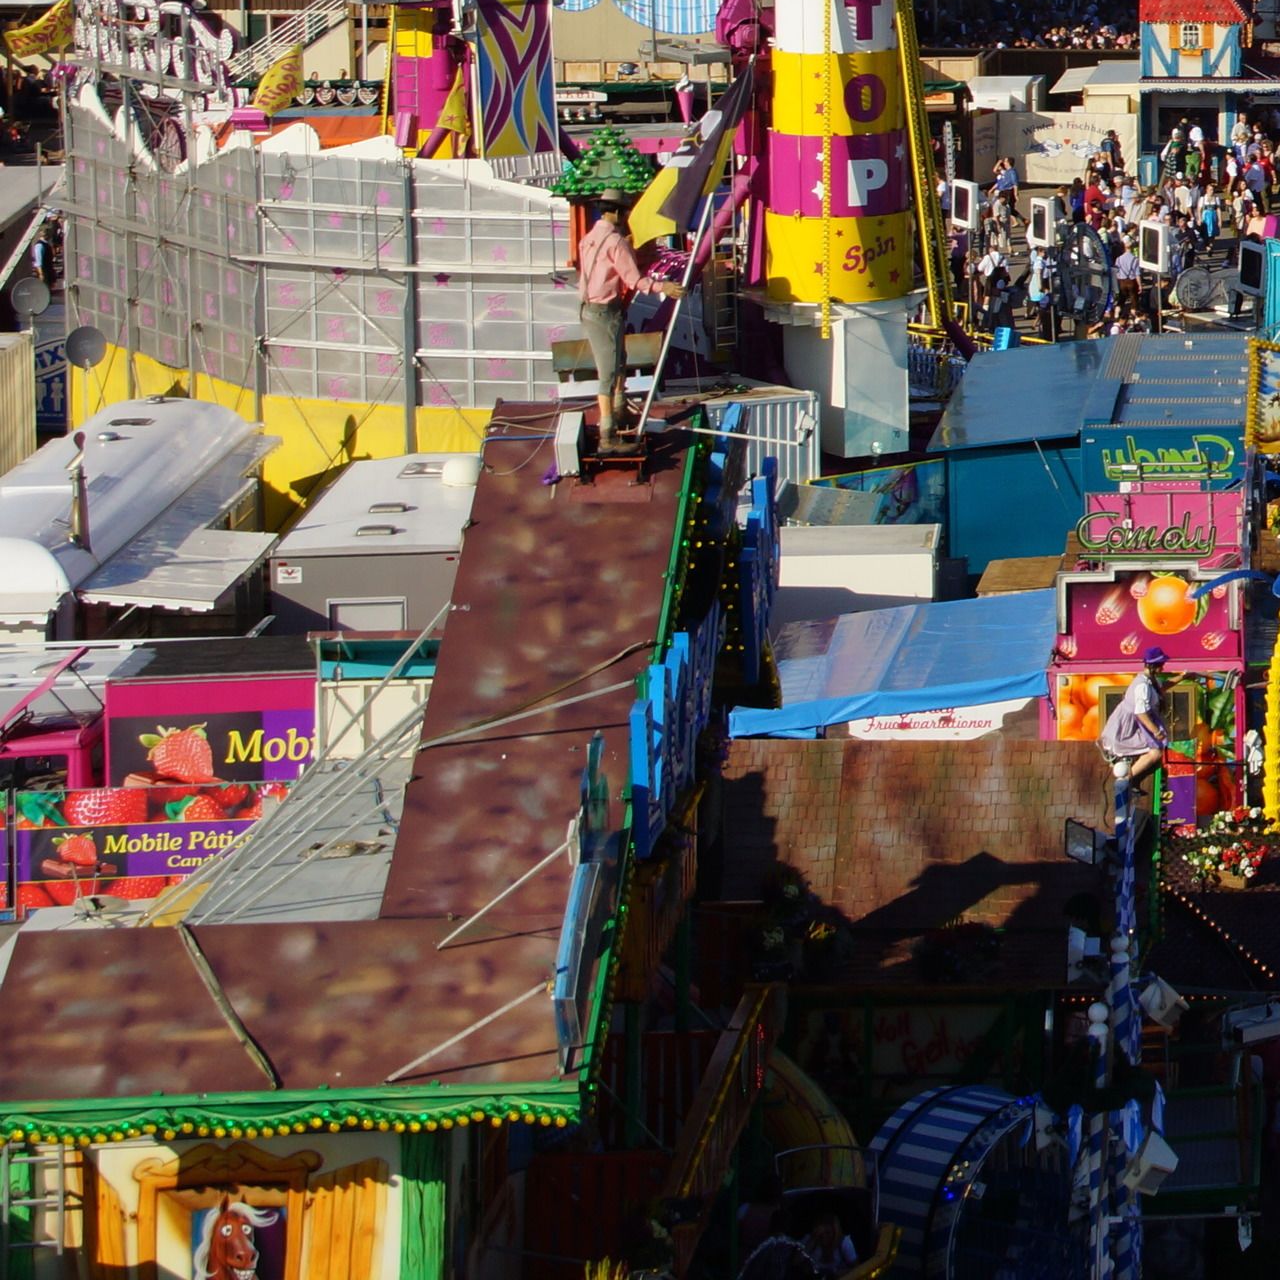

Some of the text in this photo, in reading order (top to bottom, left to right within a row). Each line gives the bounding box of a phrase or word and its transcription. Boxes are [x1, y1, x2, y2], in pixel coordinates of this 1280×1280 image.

[842, 230, 897, 275] Spin
[1076, 511, 1217, 559] Candy
[104, 832, 183, 854] Mobile
